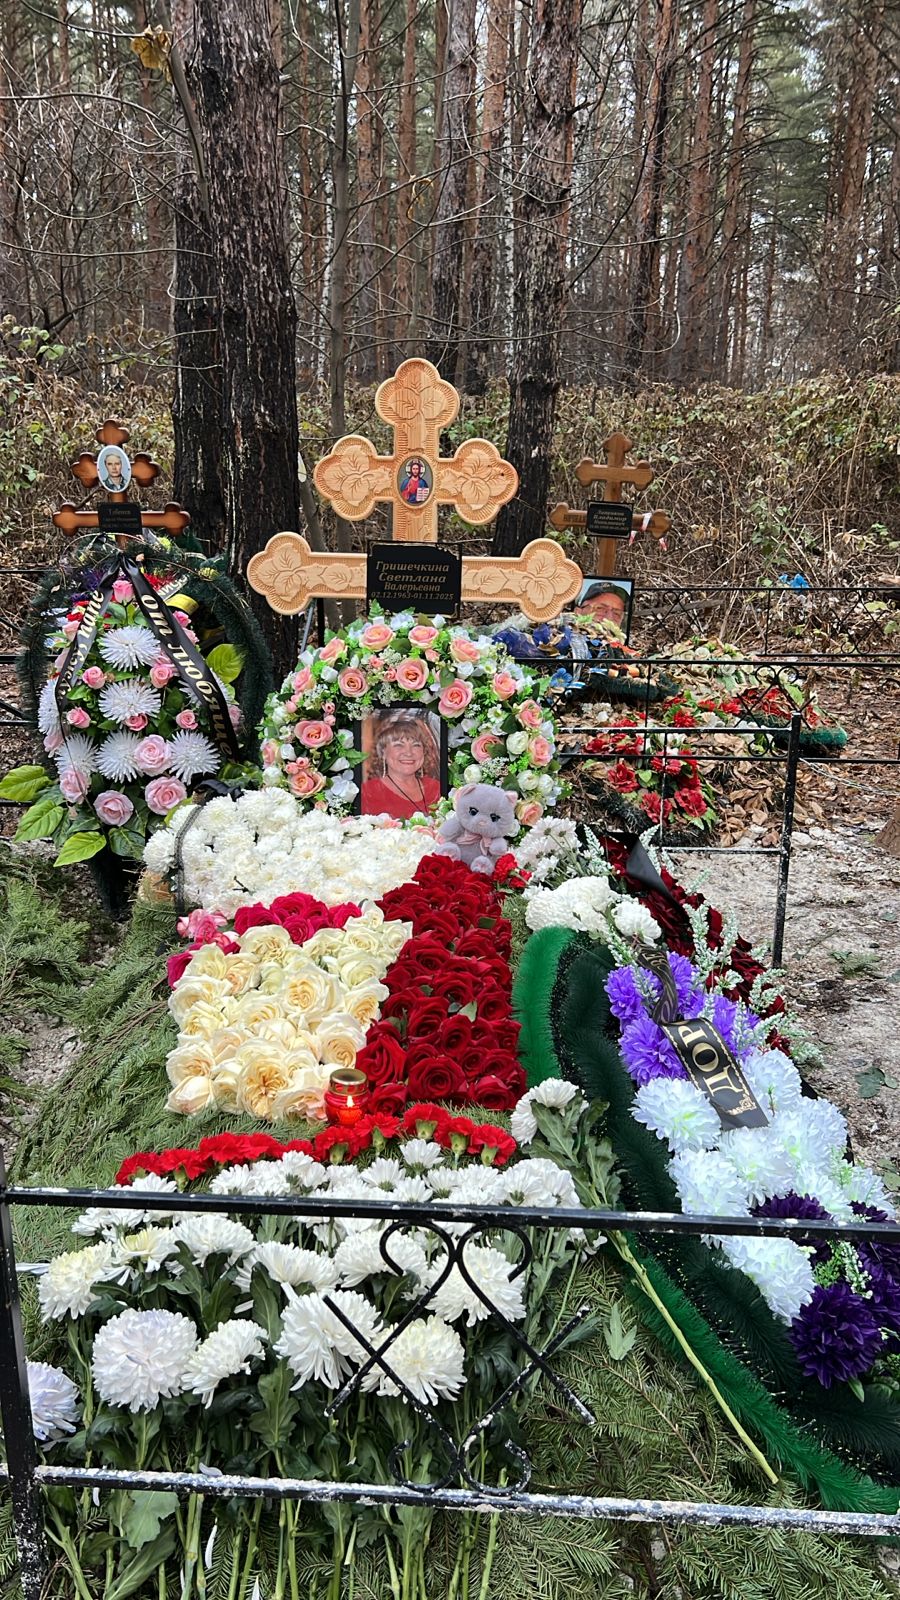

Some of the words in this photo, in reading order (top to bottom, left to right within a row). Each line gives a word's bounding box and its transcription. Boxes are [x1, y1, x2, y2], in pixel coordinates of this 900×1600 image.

[375, 560, 450, 572] Гришечкина
[378, 572, 447, 583] Светлана
[383, 582, 441, 592] Валерьевна
[371, 591, 455, 600] 02.12.1963-01.11.2025
[79, 589, 105, 639] папе
[141, 594, 174, 637] от
[677, 1024, 744, 1097] ДОР
